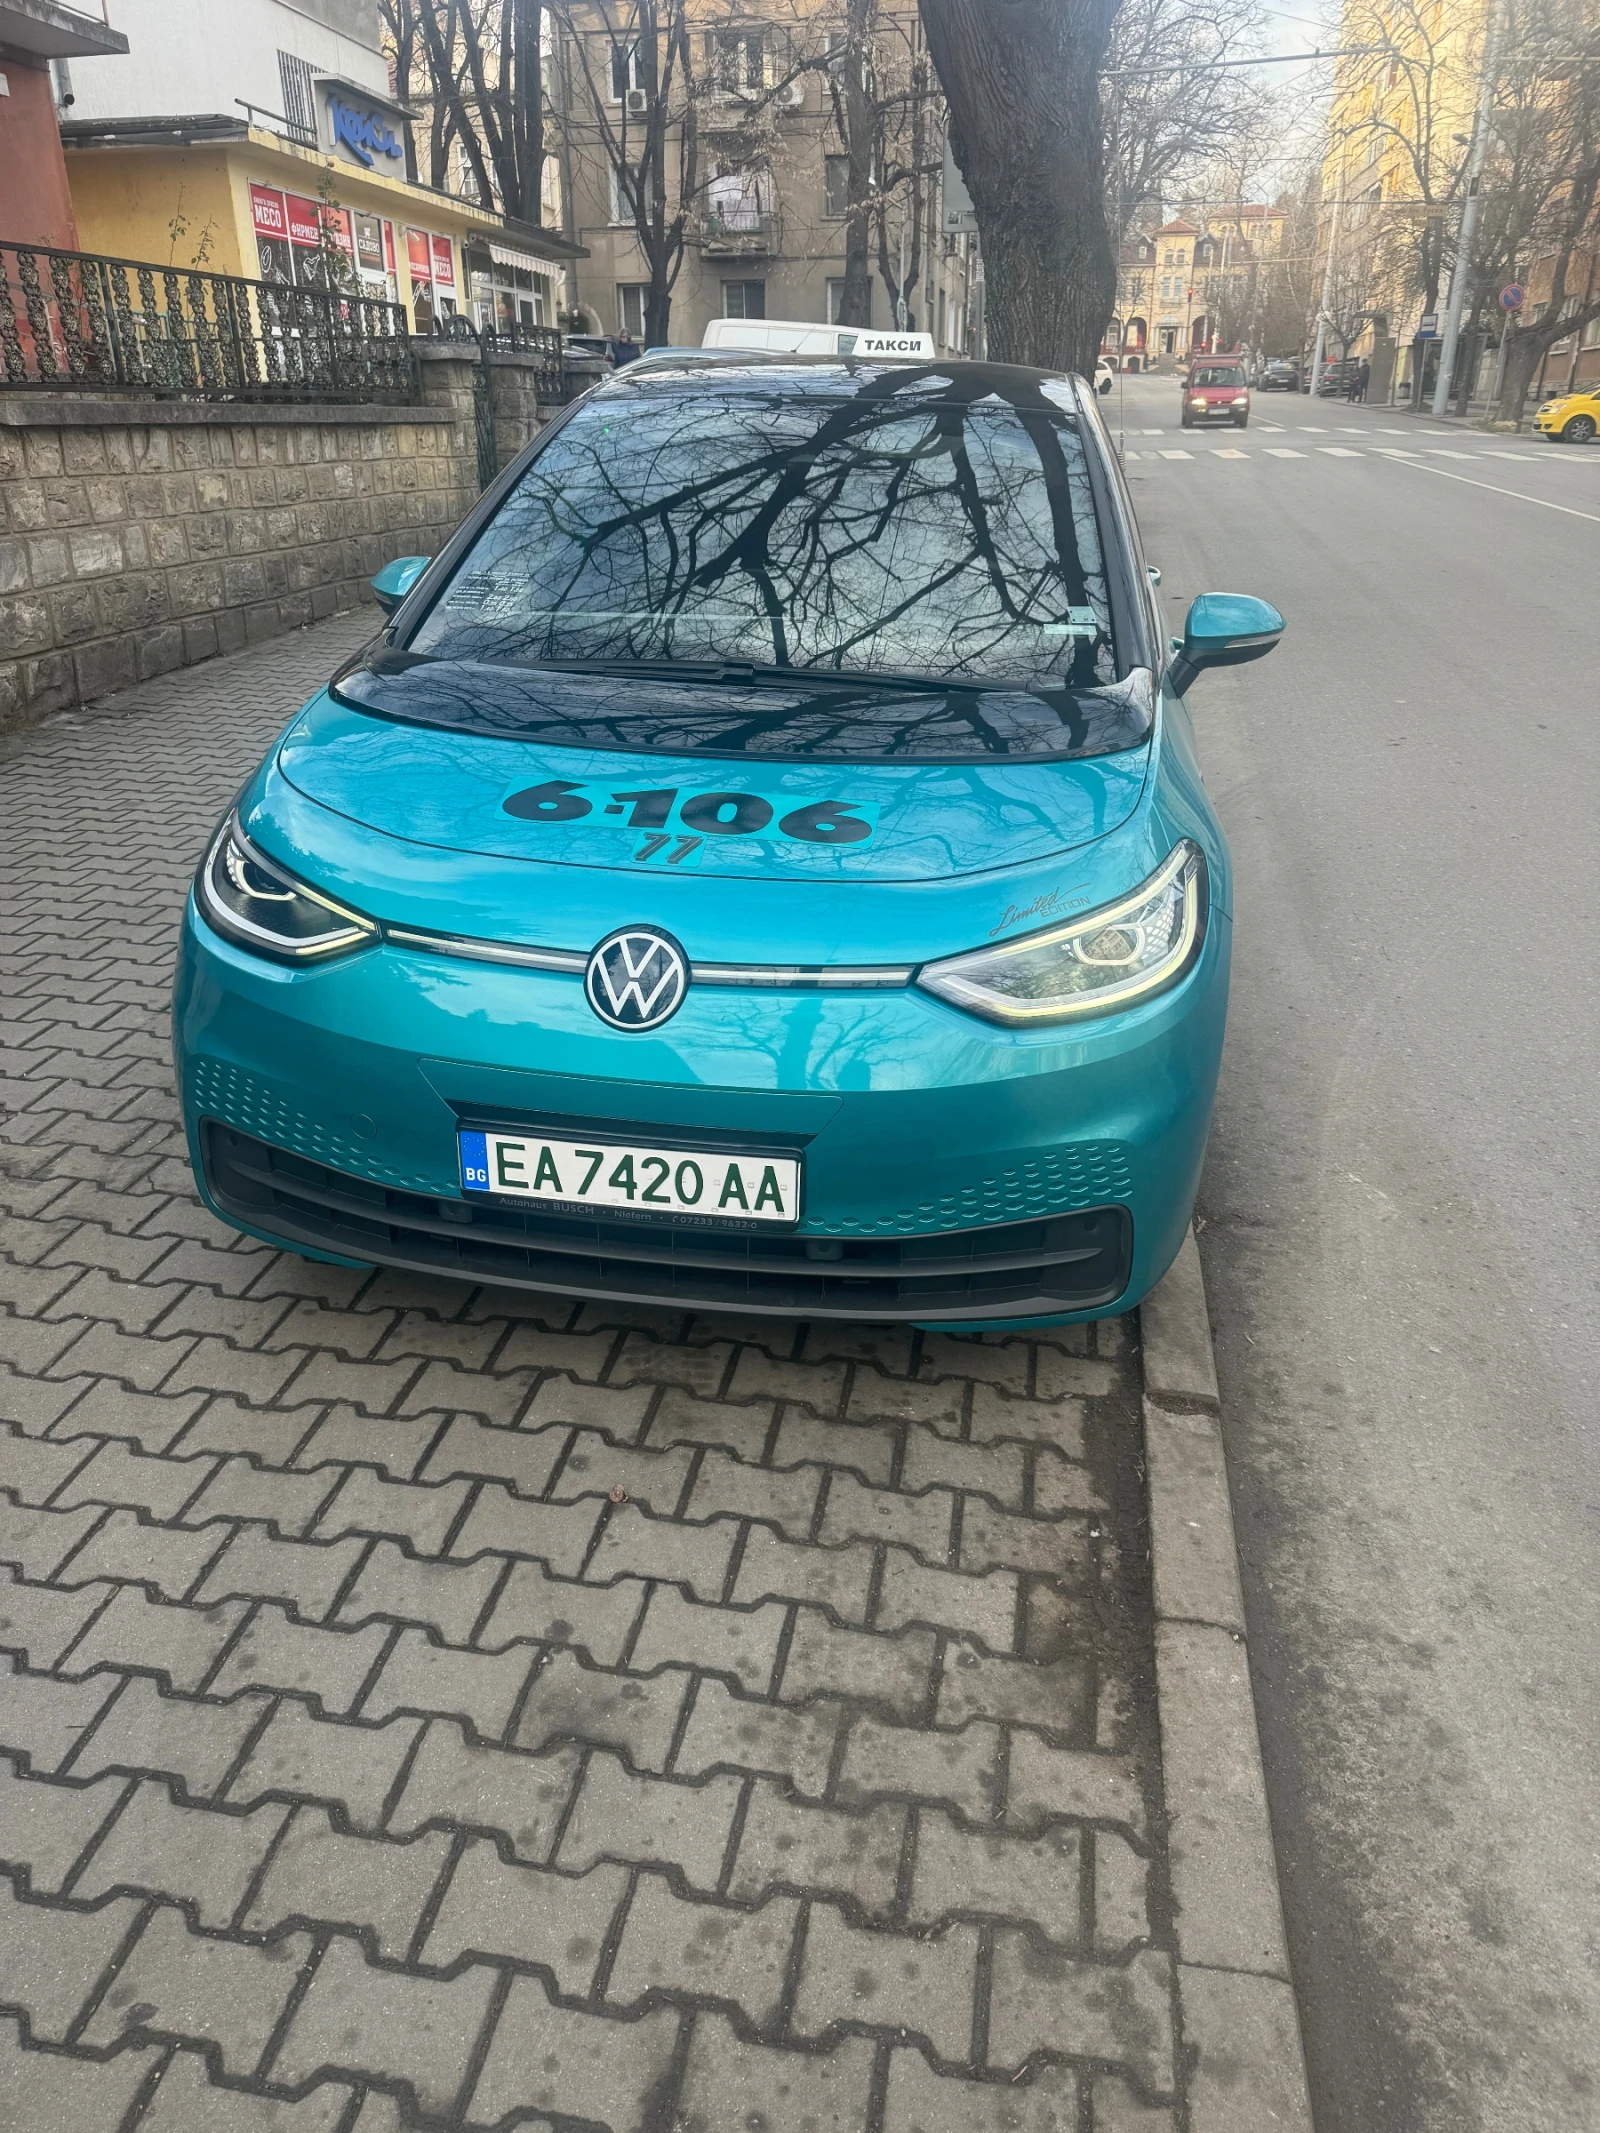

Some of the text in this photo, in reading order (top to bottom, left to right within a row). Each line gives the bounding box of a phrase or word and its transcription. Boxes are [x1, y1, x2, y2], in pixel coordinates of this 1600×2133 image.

[254, 204, 282, 228] МЕСО
[864, 339, 922, 352] ТАКСИ
[502, 779, 873, 844] 6-106
[989, 883, 1091, 937] Limited
[1039, 896, 1091, 918] EDITION
[465, 1167, 487, 1182] BG
[496, 1141, 785, 1213] EA 7420 AA
[500, 1197, 547, 1209] Autohaus
[553, 1202, 595, 1215] BUSCH
